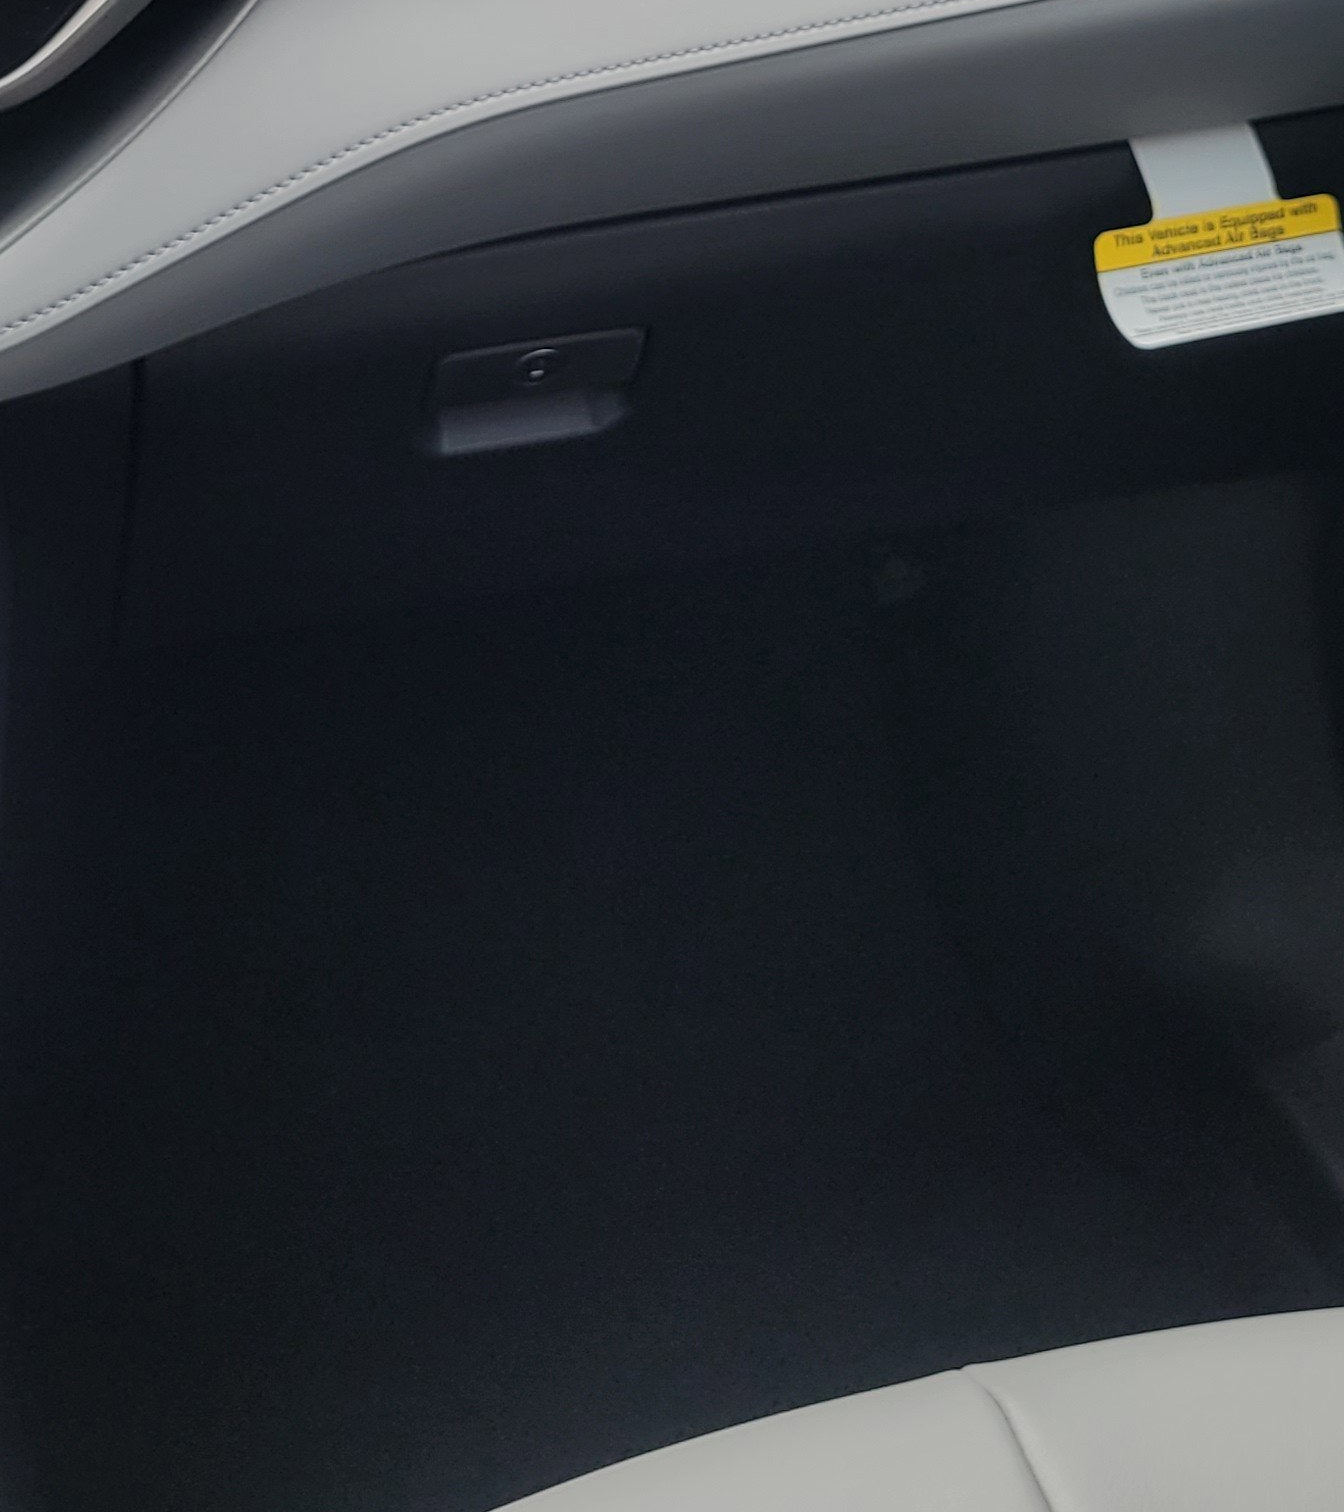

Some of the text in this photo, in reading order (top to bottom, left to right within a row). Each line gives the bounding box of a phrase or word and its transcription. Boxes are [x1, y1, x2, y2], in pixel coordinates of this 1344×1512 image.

[1113, 201, 1318, 248] This Vehicle is Equipped with
[1152, 224, 1285, 257] Advanced Air Bags
